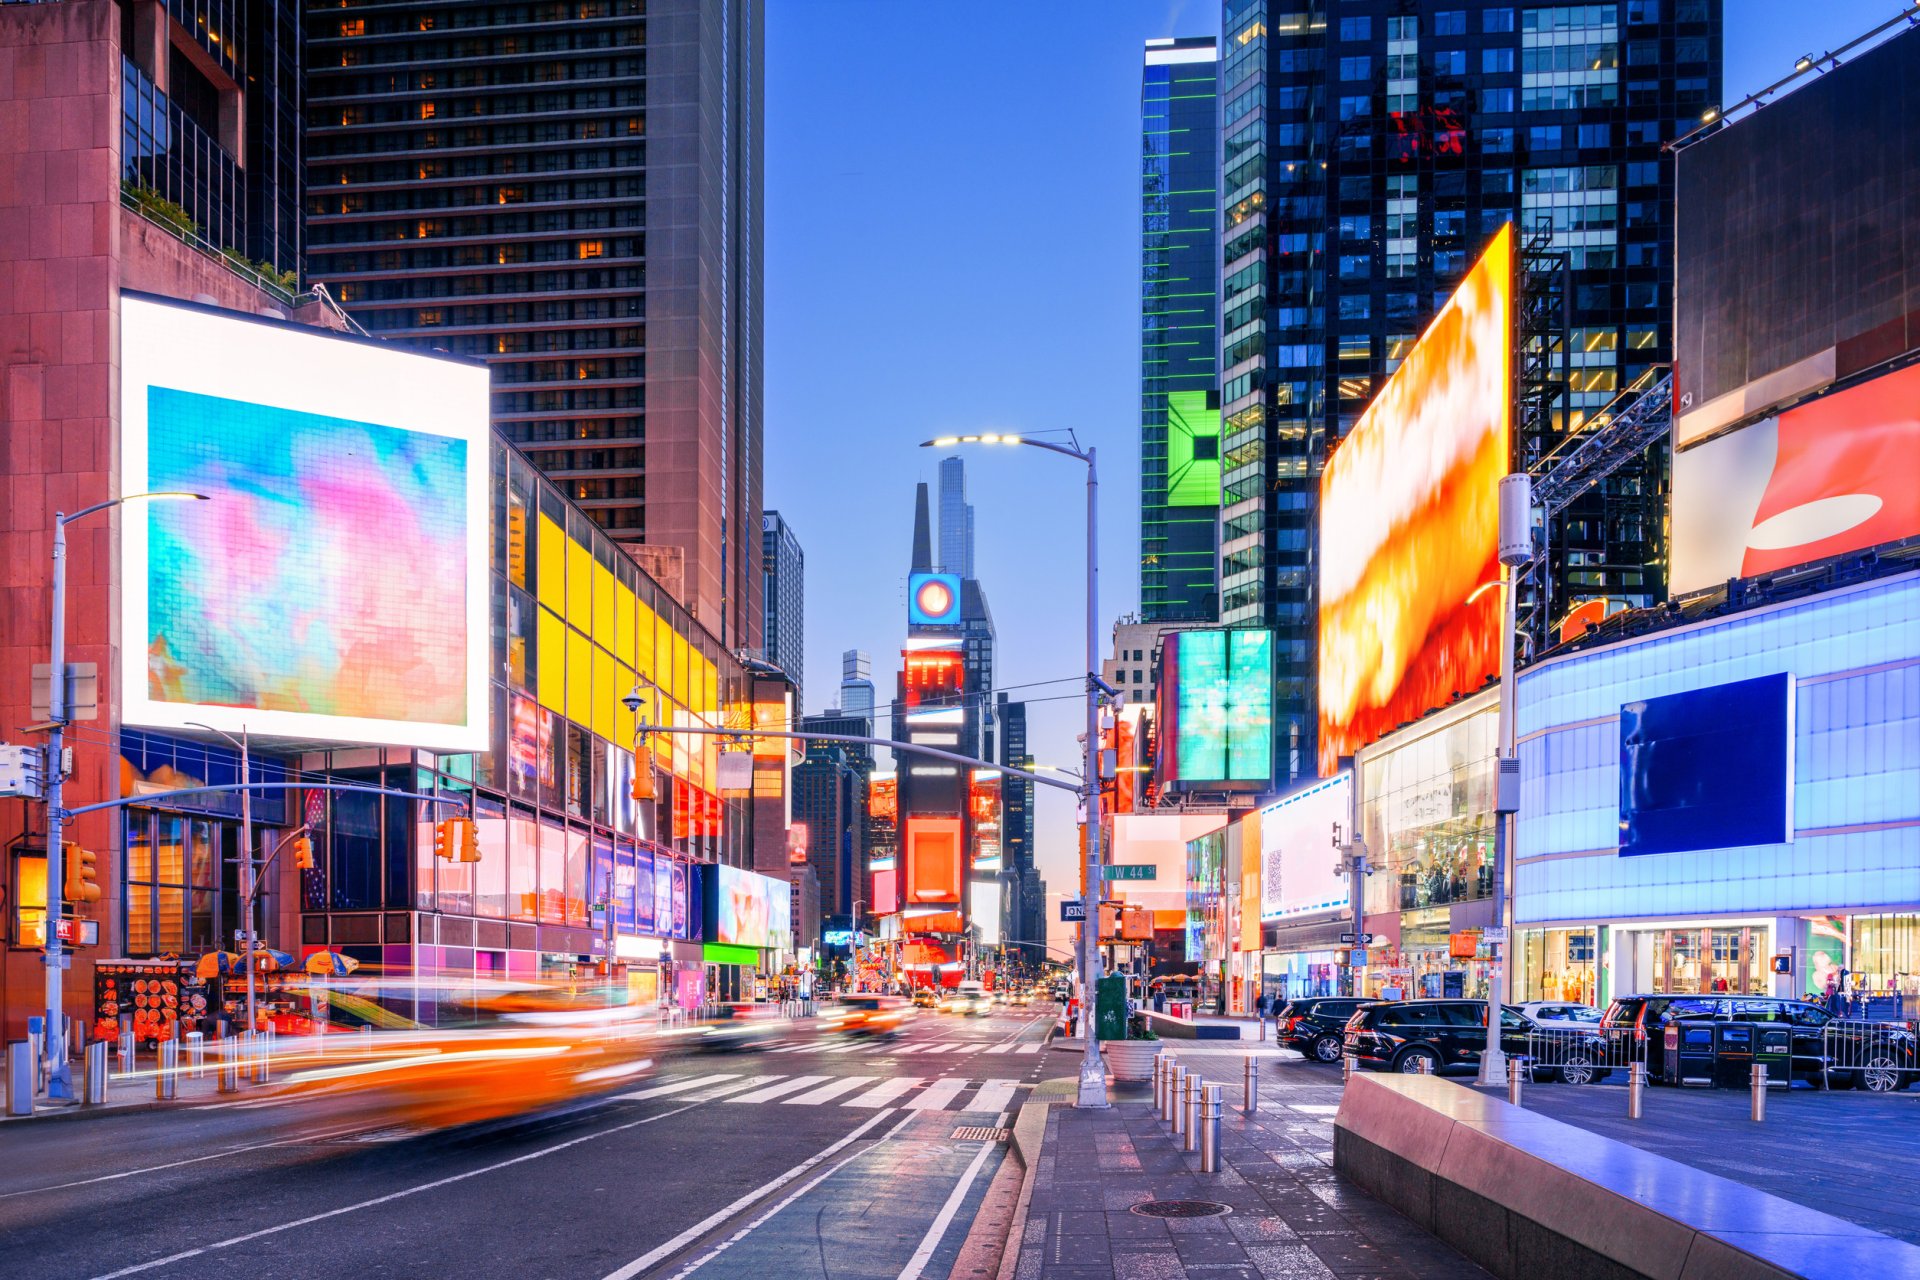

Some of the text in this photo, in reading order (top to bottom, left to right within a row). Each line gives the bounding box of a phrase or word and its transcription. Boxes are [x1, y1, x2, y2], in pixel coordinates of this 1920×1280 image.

[1115, 866, 1155, 879] W 44 St
